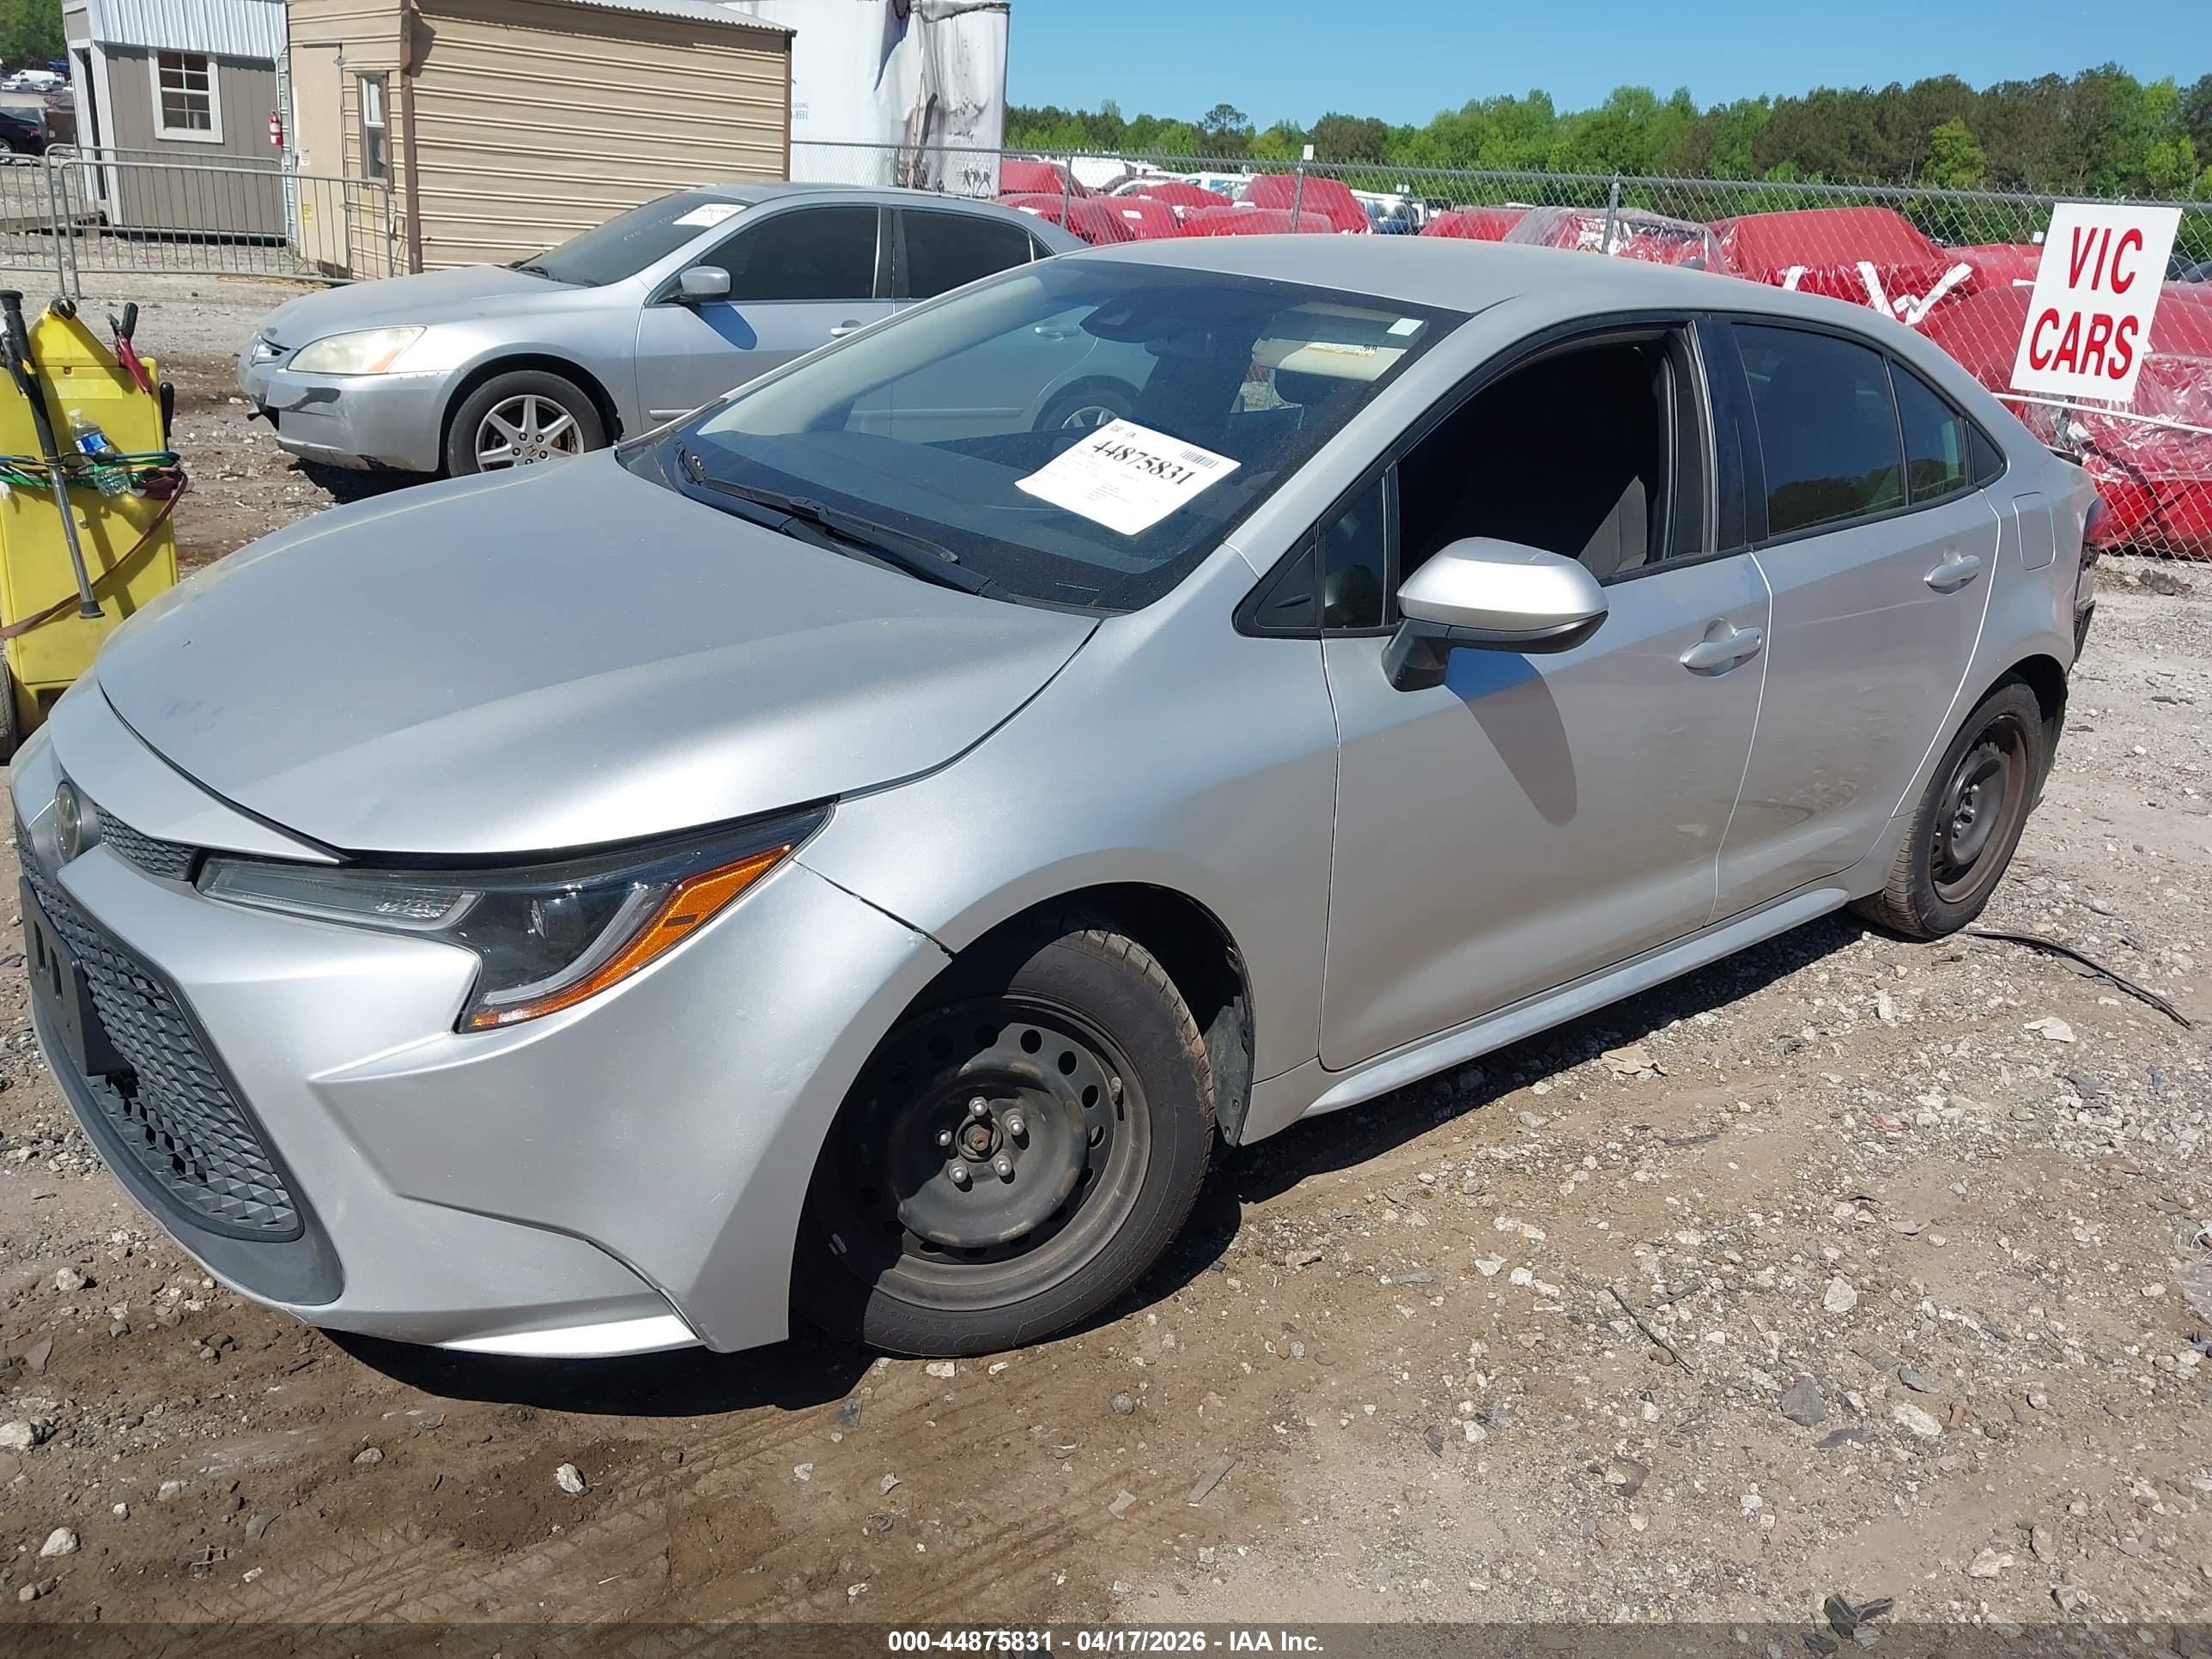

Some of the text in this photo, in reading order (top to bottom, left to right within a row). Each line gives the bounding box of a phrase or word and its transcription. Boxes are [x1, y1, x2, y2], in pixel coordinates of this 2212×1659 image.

[2068, 226, 2143, 295] VIC
[2029, 307, 2139, 380] CARS
[1092, 440, 1196, 486] 44875831
